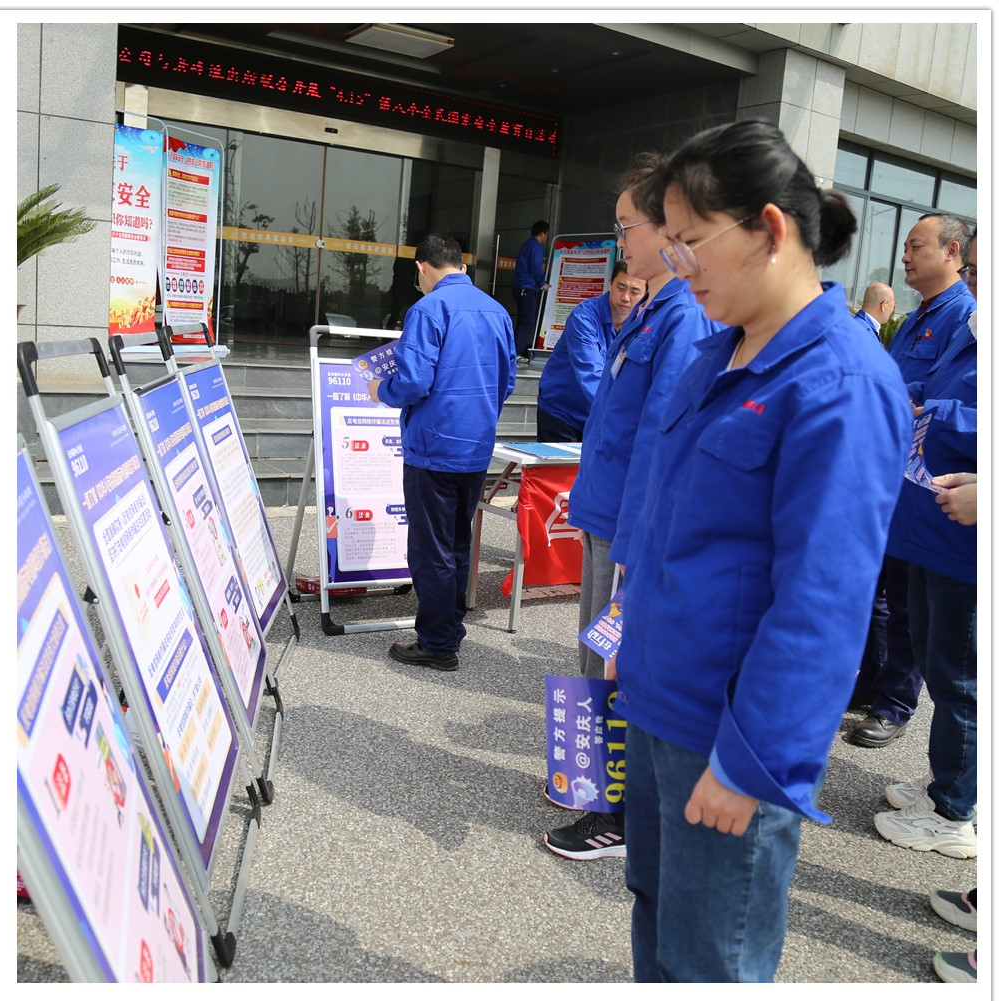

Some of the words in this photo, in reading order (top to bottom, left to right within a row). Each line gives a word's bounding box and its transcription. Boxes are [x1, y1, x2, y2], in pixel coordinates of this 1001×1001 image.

[327, 377, 351, 385] 96110
[342, 436, 350, 449] 5
[345, 506, 353, 520] 6
[553, 687, 566, 761] 警方提示
[575, 696, 592, 769] @安庆人
